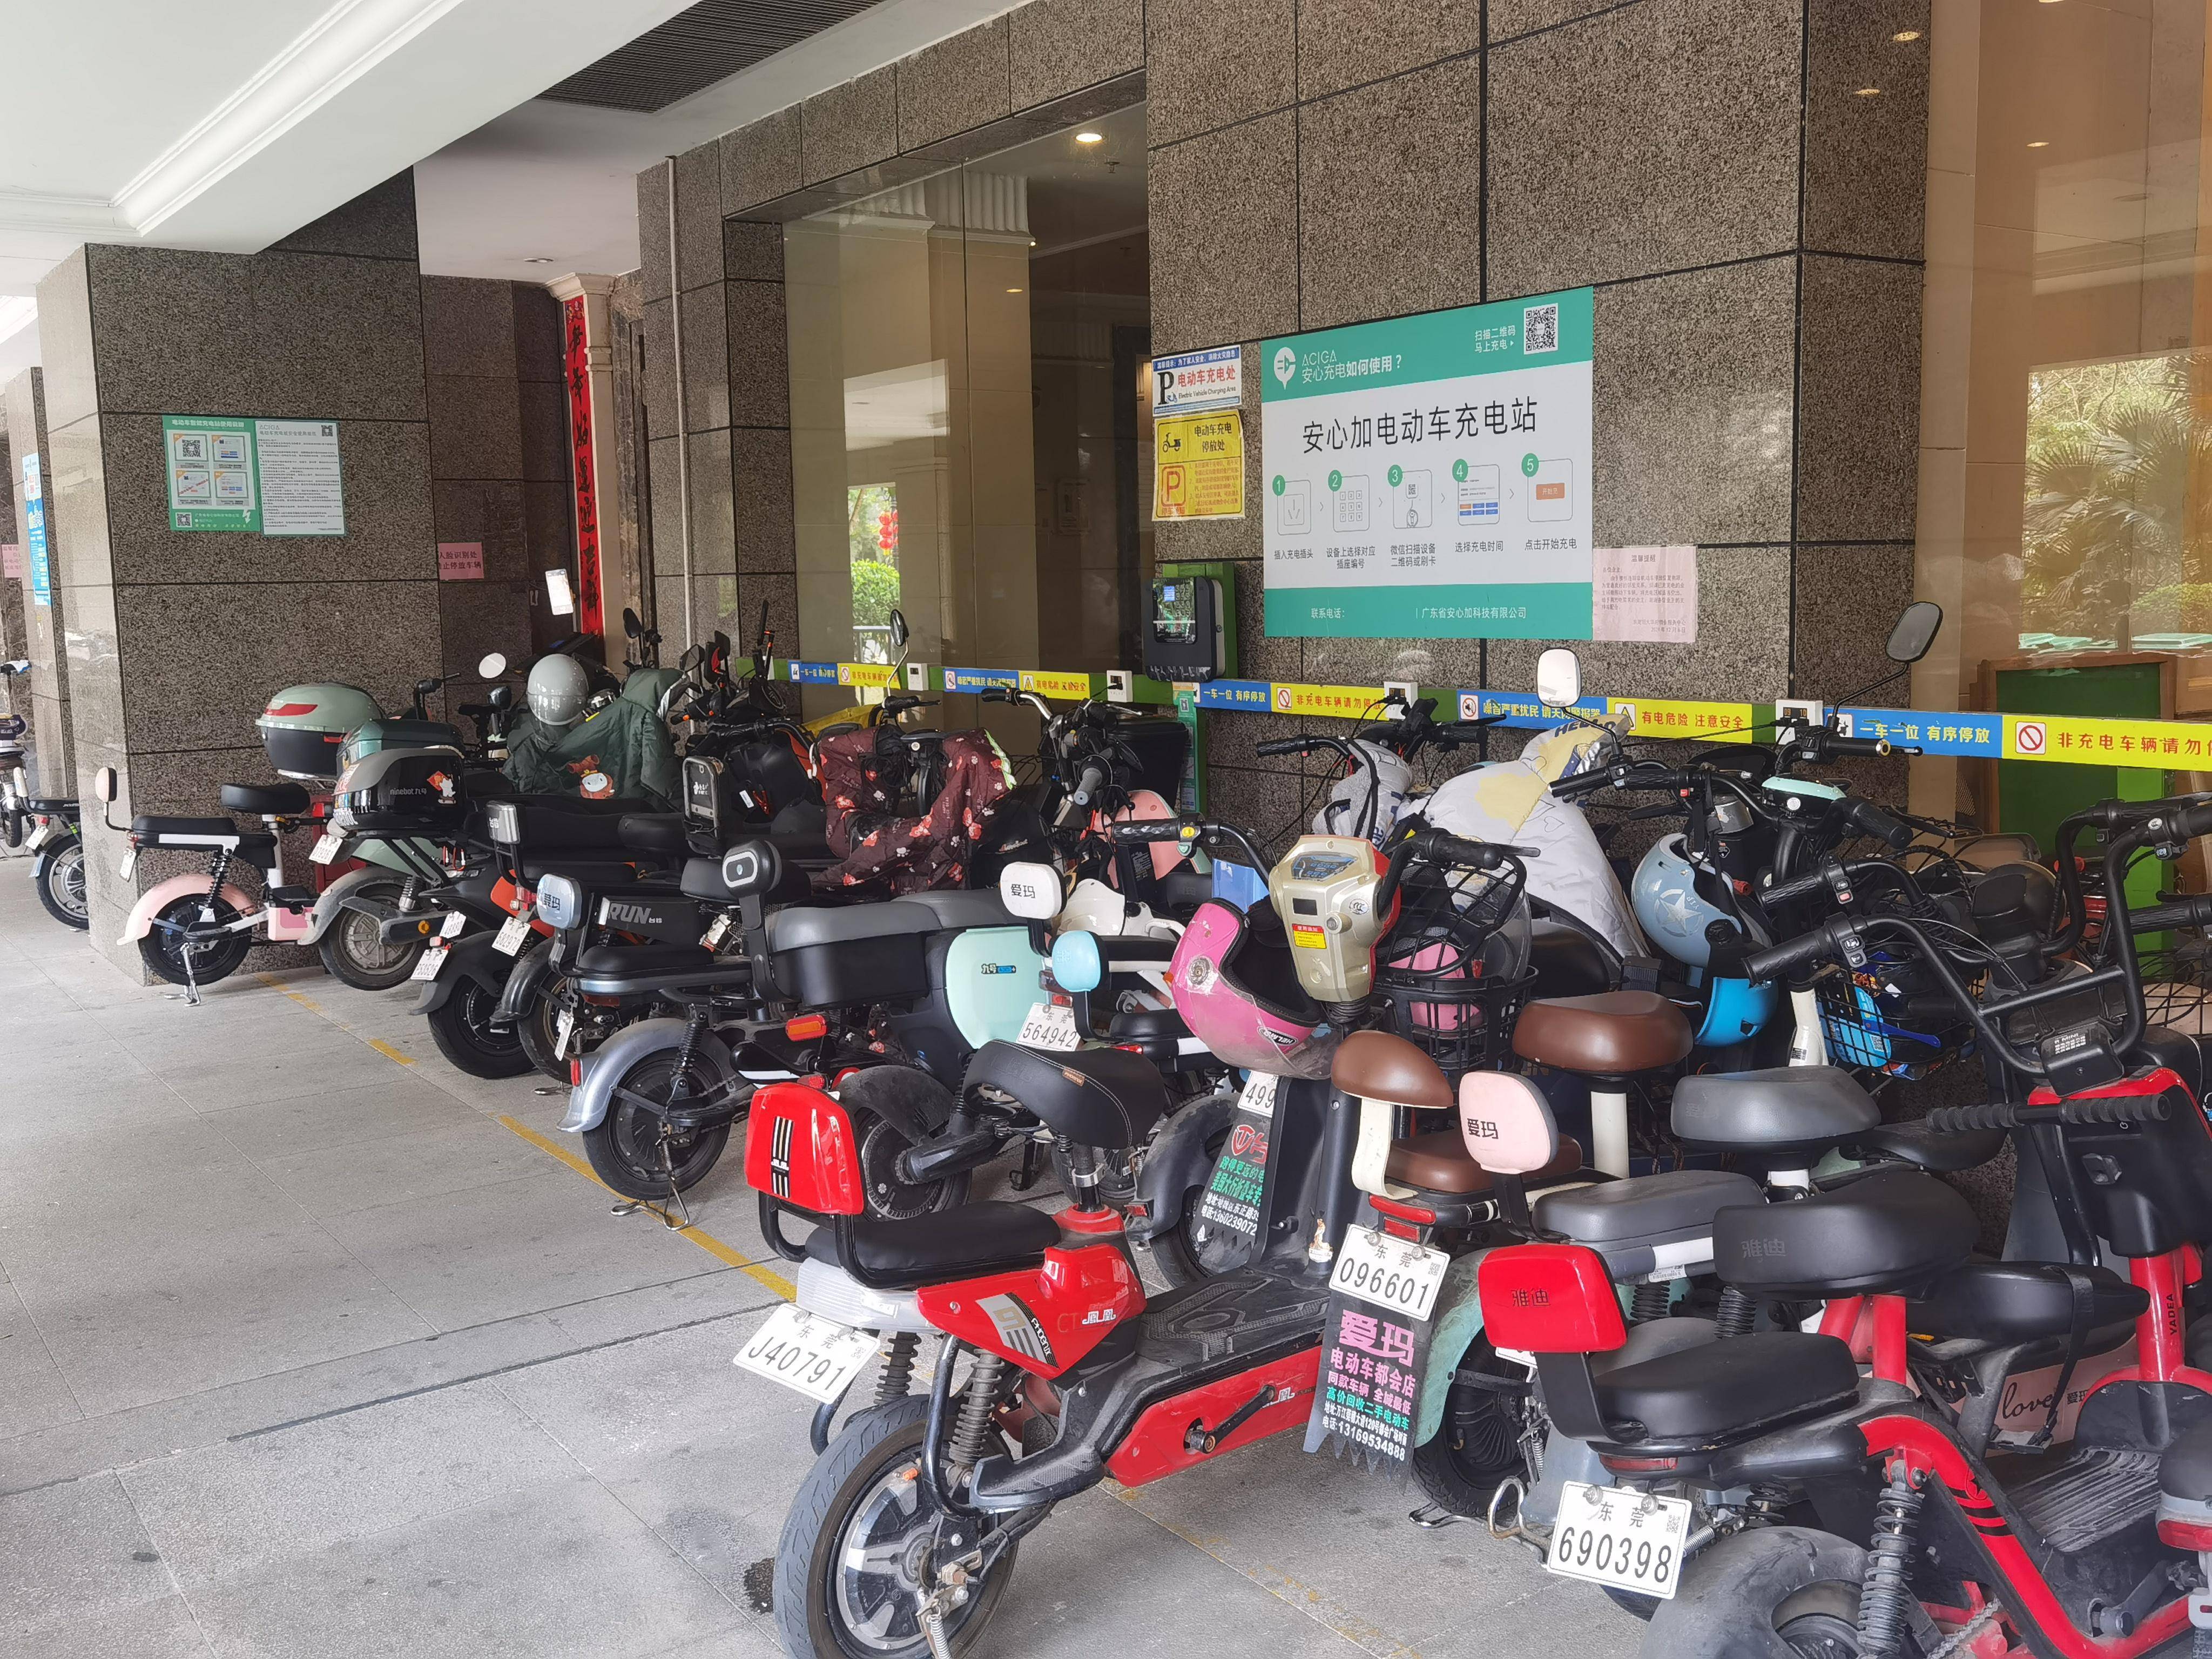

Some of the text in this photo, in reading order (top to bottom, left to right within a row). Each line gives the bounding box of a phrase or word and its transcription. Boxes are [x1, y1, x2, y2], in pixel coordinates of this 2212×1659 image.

[1475, 325, 1515, 341] 扫描二维码
[1475, 339, 1507, 353] 马上充电
[1302, 349, 1337, 367] ACIGA
[1178, 365, 1236, 387] 电动车充电处
[1157, 371, 1174, 405] P
[1208, 387, 1226, 395] Charging
[1195, 422, 1232, 437] 电动车充电
[1303, 396, 1537, 453] 安心加电动车充电站
[1202, 439, 1225, 453] 停放处
[1456, 464, 1463, 477] 4
[1527, 458, 1534, 471] 5
[1332, 475, 1338, 487] 2
[1392, 470, 1398, 482] 3
[1326, 545, 1375, 558] 设备上选择对应
[1391, 543, 1435, 555] 微信扫描设备
[1455, 540, 1503, 552] 选择充电时间
[1525, 538, 1577, 550] 点击开始充电
[440, 551, 477, 559] 人脸识别处
[1274, 548, 1313, 559] 插入充电插头
[1391, 556, 1436, 568] 二维码或刷卡
[1337, 558, 1365, 569] 插座编号
[1422, 606, 1526, 619] 广东省安心加科技有限公司
[1036, 679, 1058, 690] 有电危险
[1204, 688, 1265, 703] 一车一位 有序停放
[1297, 694, 1382, 710] 非充电车辆请勿停放
[1483, 702, 1539, 718] 噪音严重扰民
[1642, 711, 1743, 729] 有电危险 注意安全
[1860, 722, 1990, 743] 一车一位 有序停放
[1011, 884, 1036, 898] 爱玛
[544, 893, 560, 911] 爱玛
[608, 902, 651, 924] RUN
[496, 932, 520, 951] 582972
[982, 963, 996, 974] 九号
[1023, 1022, 1077, 1048] 564942
[1467, 1118, 1499, 1139] 爱玛
[1375, 1244, 1412, 1267] 东莞
[1741, 1238, 1787, 1259] 雅迪
[1340, 1258, 1428, 1309] 096601
[1512, 1289, 1550, 1308] 雅迪
[2166, 1294, 2177, 1336] YADEA
[796, 1324, 837, 1350] 东莞
[1031, 1318, 1053, 1358] PHOENIX
[1339, 1309, 1414, 1367] 爱玛
[748, 1336, 846, 1391] J40791
[1331, 1347, 1415, 1399] 电动车都会店
[1327, 1371, 1412, 1415] 同款车辆 全城最低
[1326, 1386, 1410, 1431] 高价回收二手电动车
[1599, 1501, 1643, 1528] 东莞
[1559, 1526, 1671, 1583] 690398
